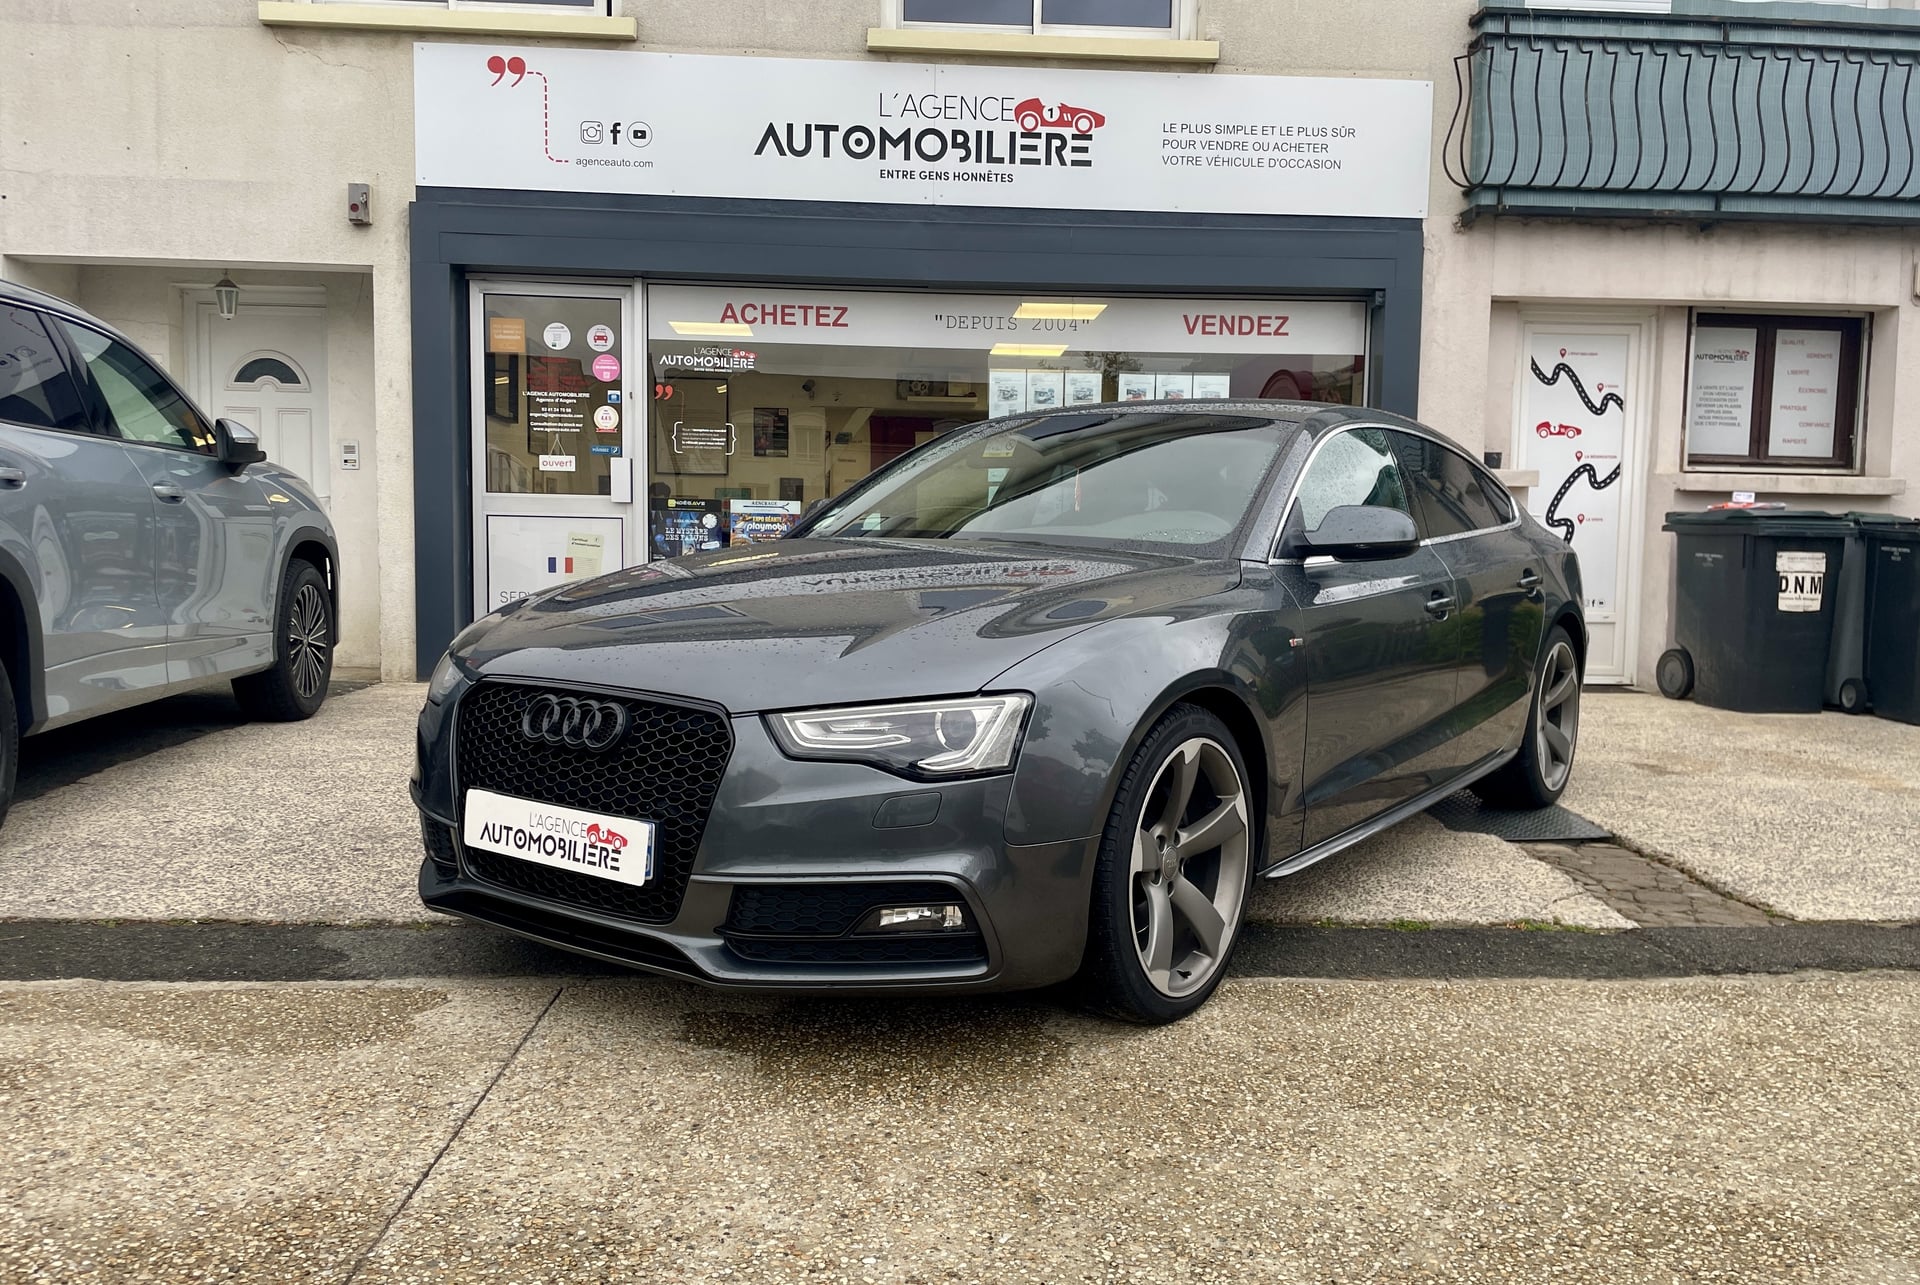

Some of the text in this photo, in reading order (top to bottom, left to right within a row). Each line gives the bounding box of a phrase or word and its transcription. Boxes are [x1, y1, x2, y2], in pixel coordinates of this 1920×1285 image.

[880, 92, 1016, 122] L'AGENCE
[1047, 107, 1054, 119] 1
[1163, 123, 1356, 138] LE PLUS SIMPLE ET LE PLUS SÛR
[1163, 139, 1329, 153] POUR VENDRE OU ACHETER
[575, 158, 654, 168] agenceauto.com
[1162, 155, 1342, 170] VOTRE VÉHICULE D'OCCASION
[880, 169, 1014, 183] ENTRE GENS HONNÊTES
[720, 302, 849, 328] ACHETEZ
[1183, 314, 1290, 337] VENDEZ
[693, 347, 733, 356] L'AGENCE
[542, 459, 573, 467] ouvert
[746, 521, 788, 532] playmobil
[528, 811, 588, 839] L'AGENCE
